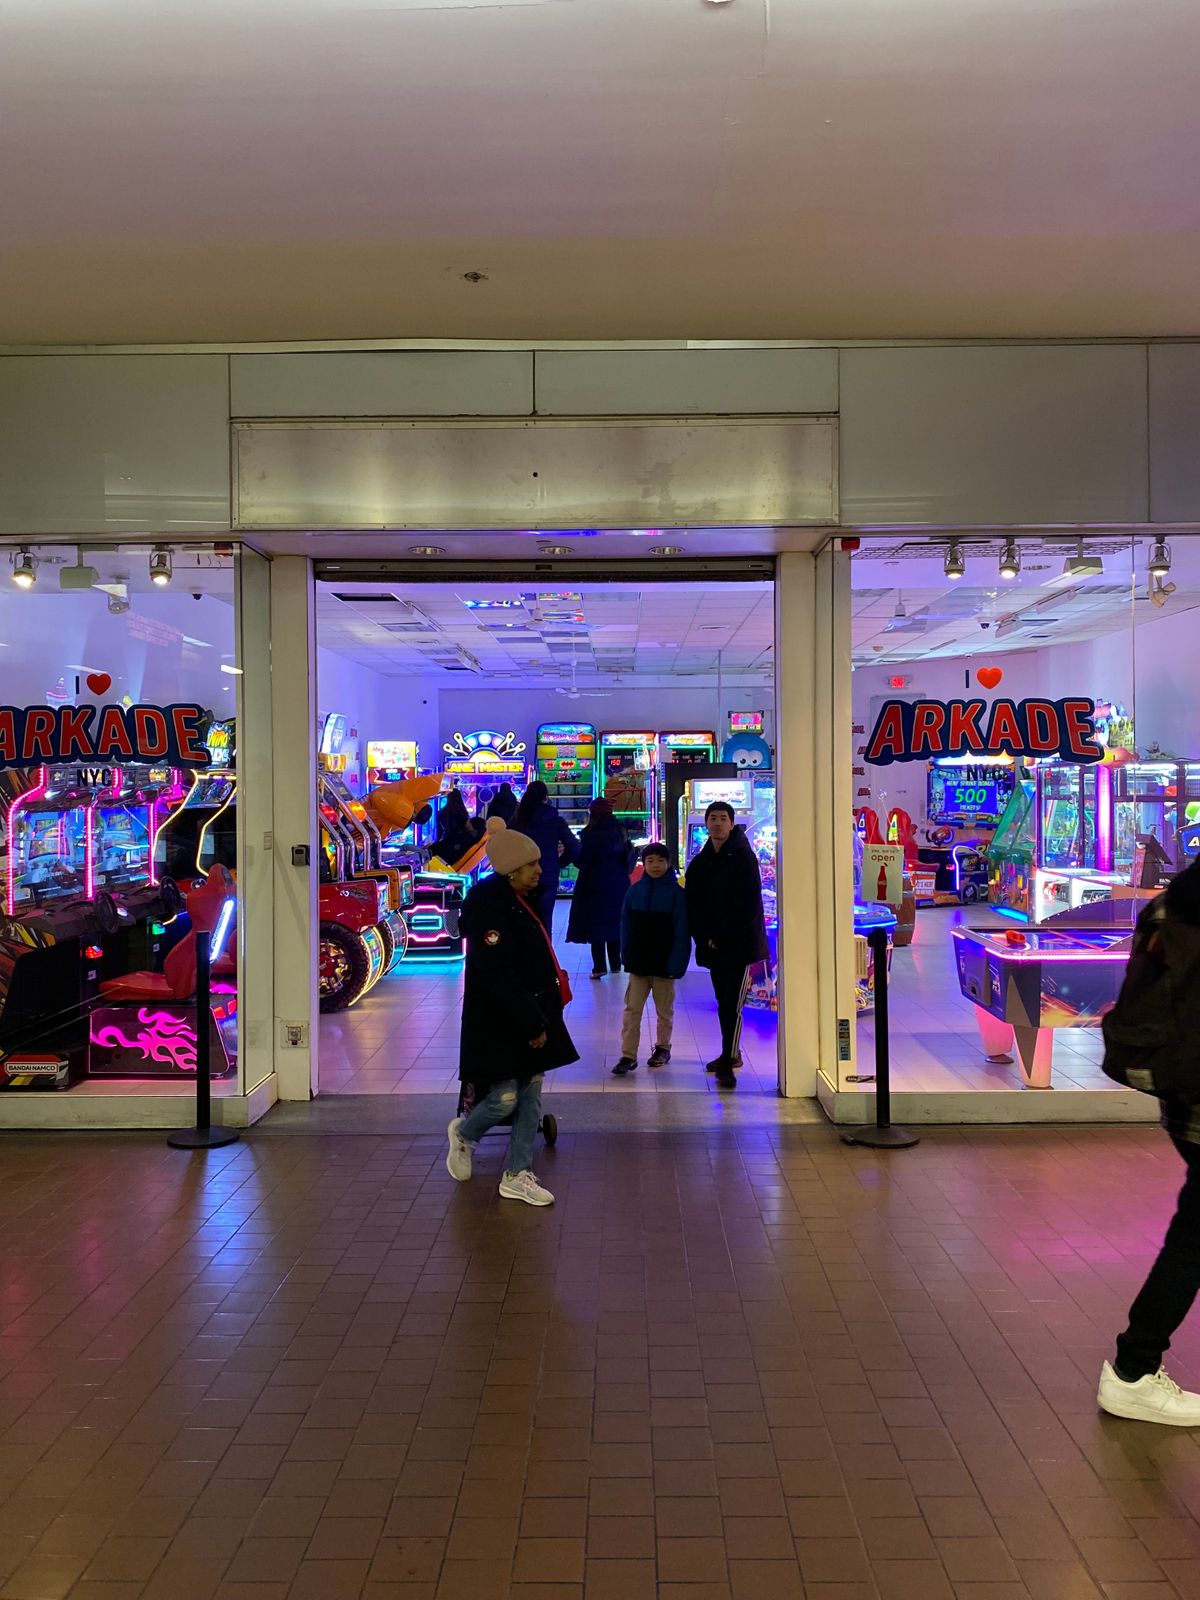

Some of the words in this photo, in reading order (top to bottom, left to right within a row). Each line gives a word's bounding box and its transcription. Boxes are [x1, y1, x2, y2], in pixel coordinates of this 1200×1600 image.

[75, 676, 79, 694] I
[965, 670, 970, 688] I
[0, 705, 210, 767] ARKADE
[866, 699, 1103, 763] ARKADE
[478, 762, 524, 773] MASTER
[77, 769, 112, 787] NYC
[954, 788, 987, 804] 500
[871, 854, 895, 862] open
